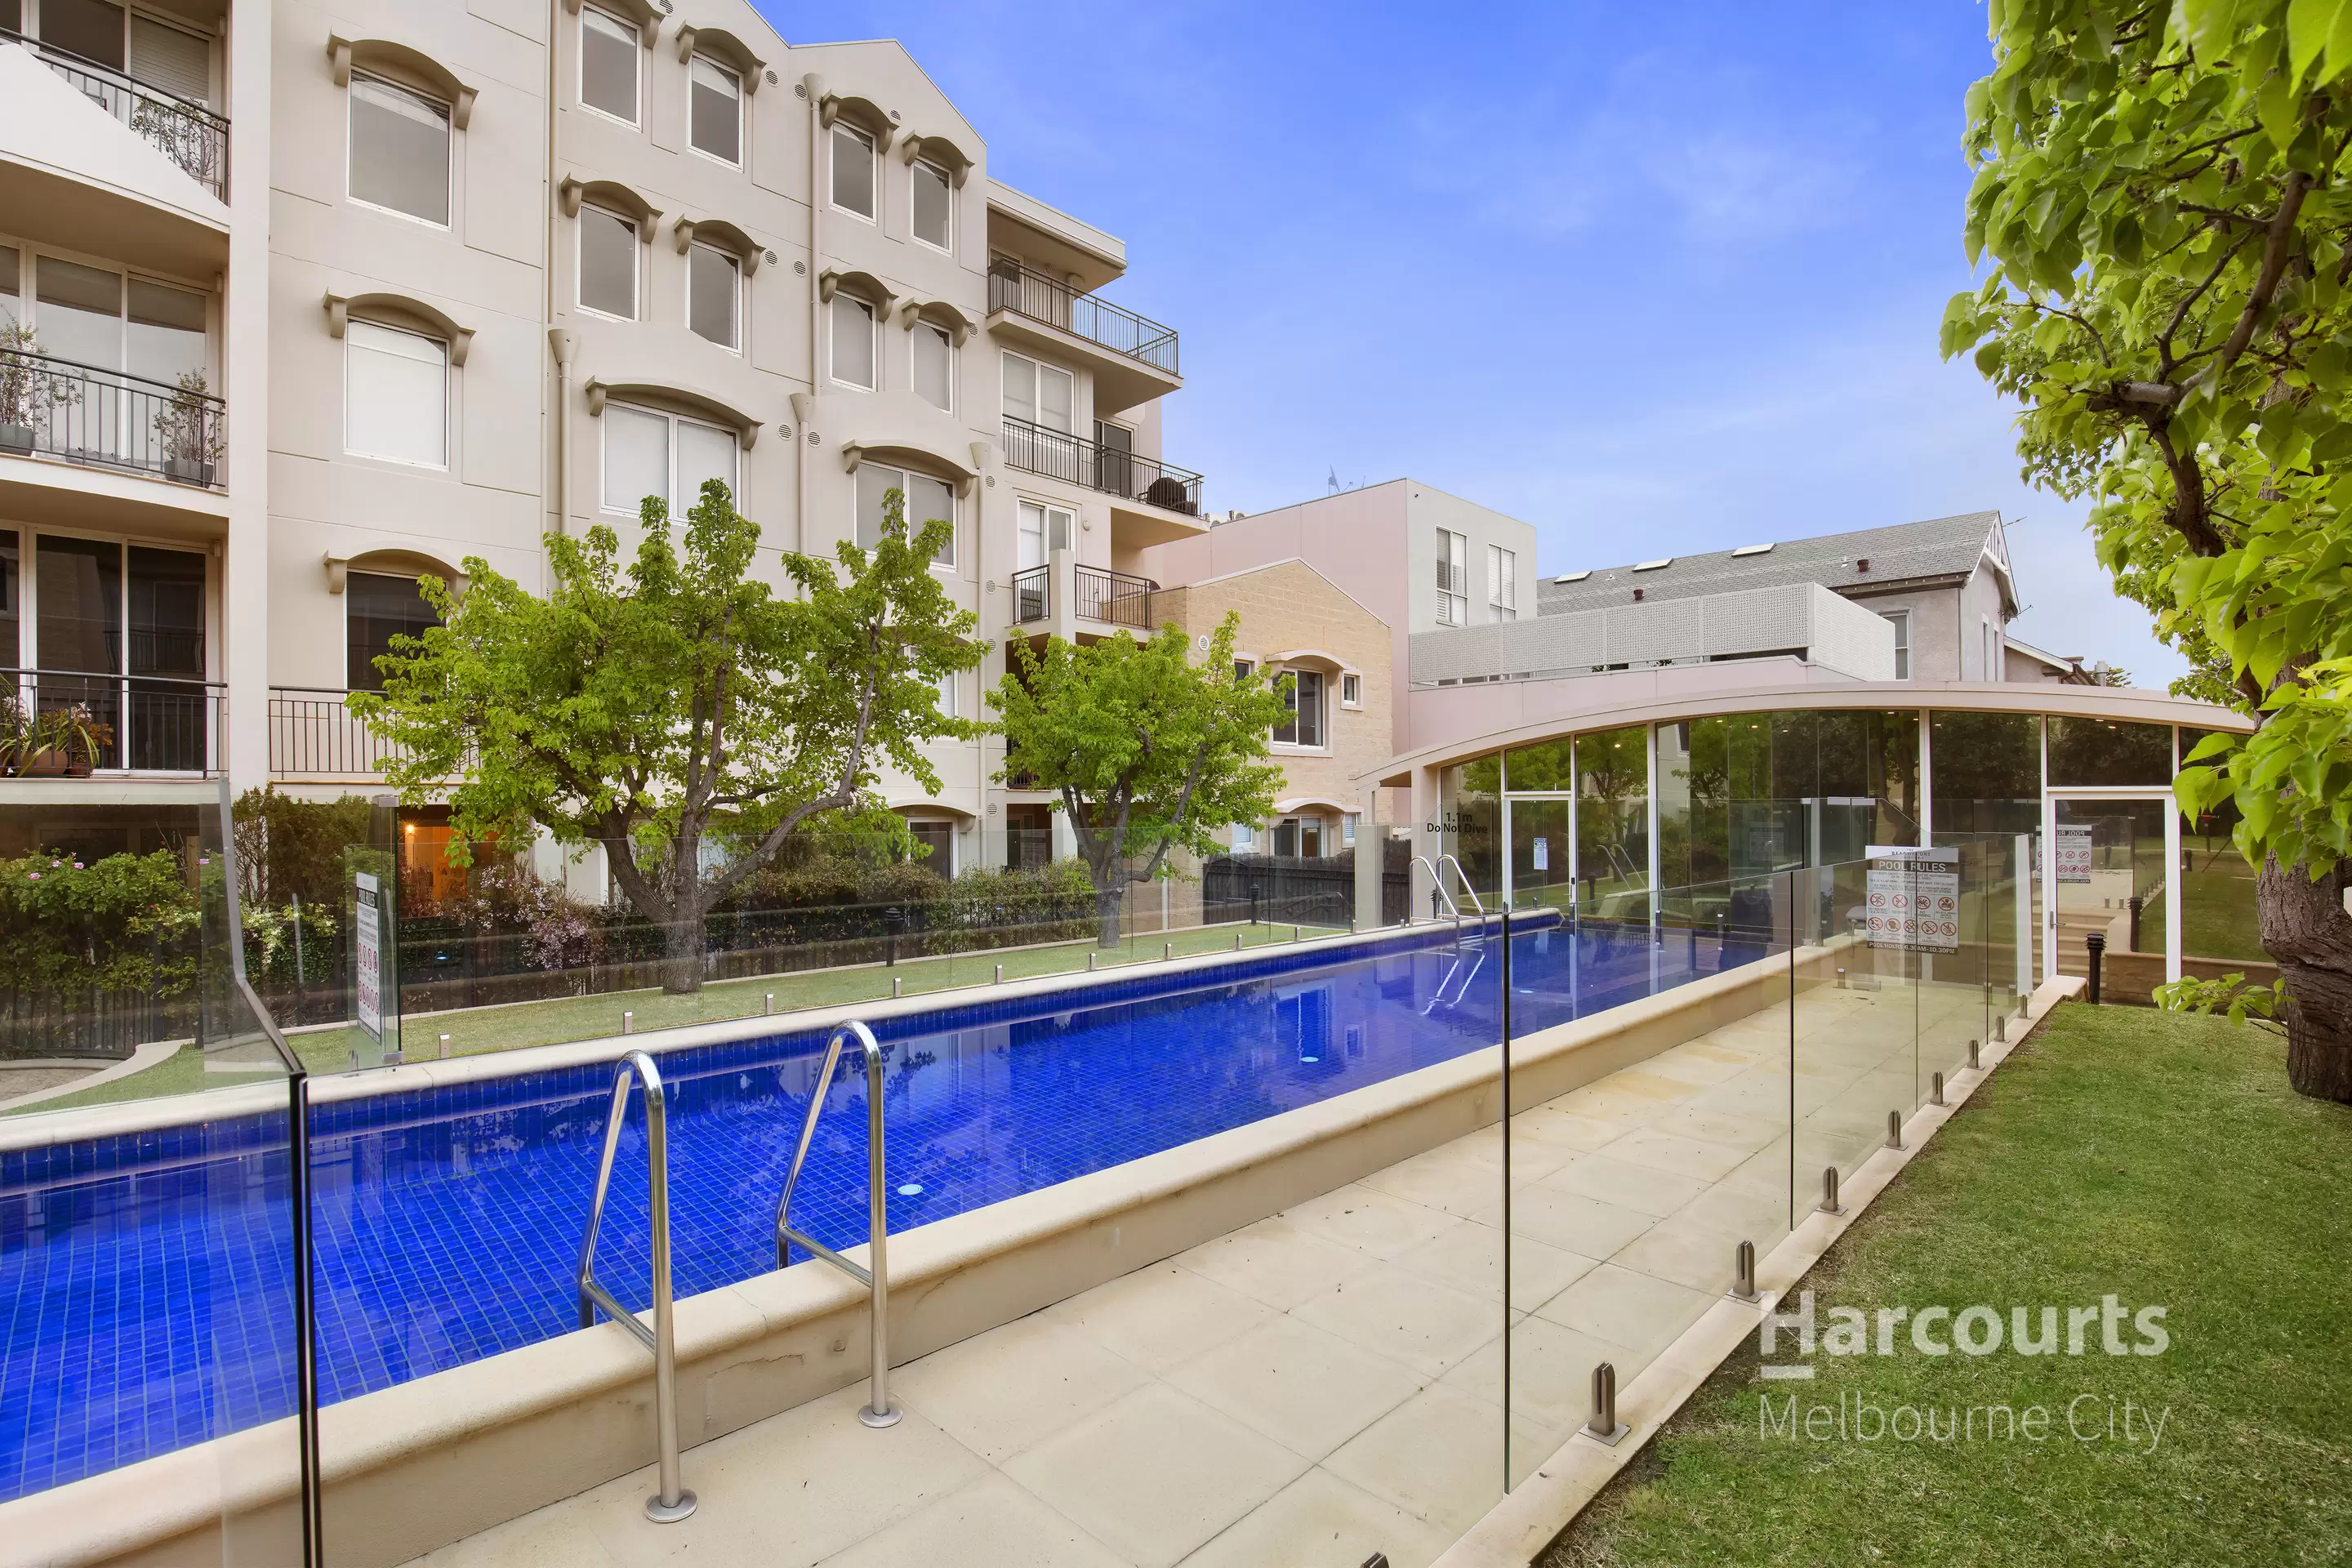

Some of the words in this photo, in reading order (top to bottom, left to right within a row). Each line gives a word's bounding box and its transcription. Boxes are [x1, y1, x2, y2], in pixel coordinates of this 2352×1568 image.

[1446, 813, 1472, 822] 1.1m
[1427, 823, 1441, 832] Do
[1443, 823, 1461, 833] Not
[1464, 823, 1488, 833] Dive
[1878, 861, 1907, 871] POOL
[1911, 862, 1946, 872] RULES
